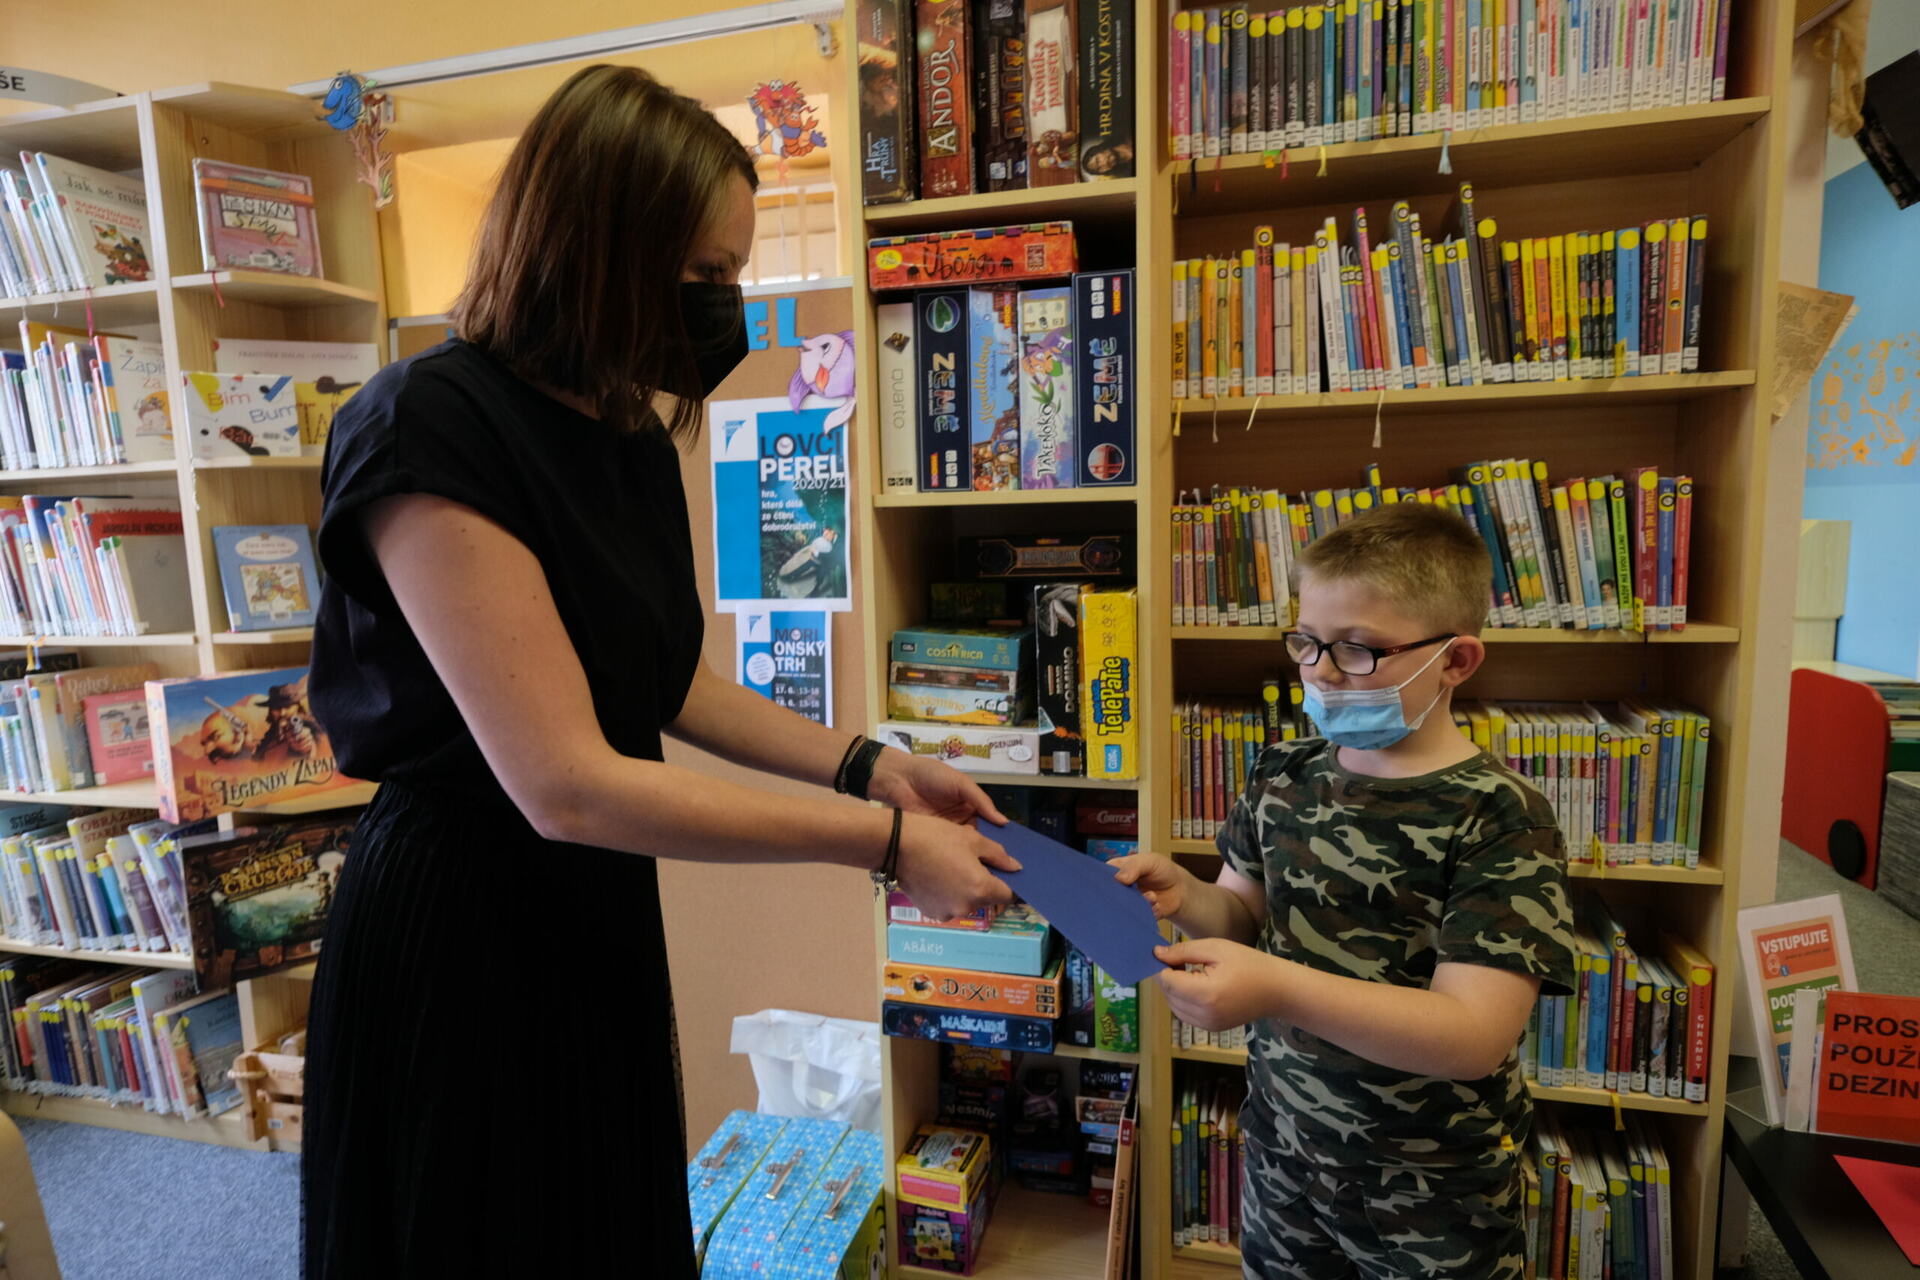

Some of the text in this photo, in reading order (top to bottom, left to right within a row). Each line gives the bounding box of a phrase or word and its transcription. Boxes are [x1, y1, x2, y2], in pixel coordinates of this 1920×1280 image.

[928, 40, 959, 153] ANDOR
[1099, 69, 1112, 137] HRDINA
[760, 431, 842, 459] LOVCI
[760, 454, 846, 482] PEREL
[792, 477, 846, 491] 2020/21
[774, 657, 806, 672] TRH
[212, 768, 289, 807] LEGENDY
[223, 858, 315, 896] CRUSOE
[1760, 928, 1830, 955] VSTUPUJTE
[1769, 983, 1841, 1011] DODUJTE
[1832, 1013, 1920, 1039] PROS
[1828, 1073, 1920, 1099] DEZIN
